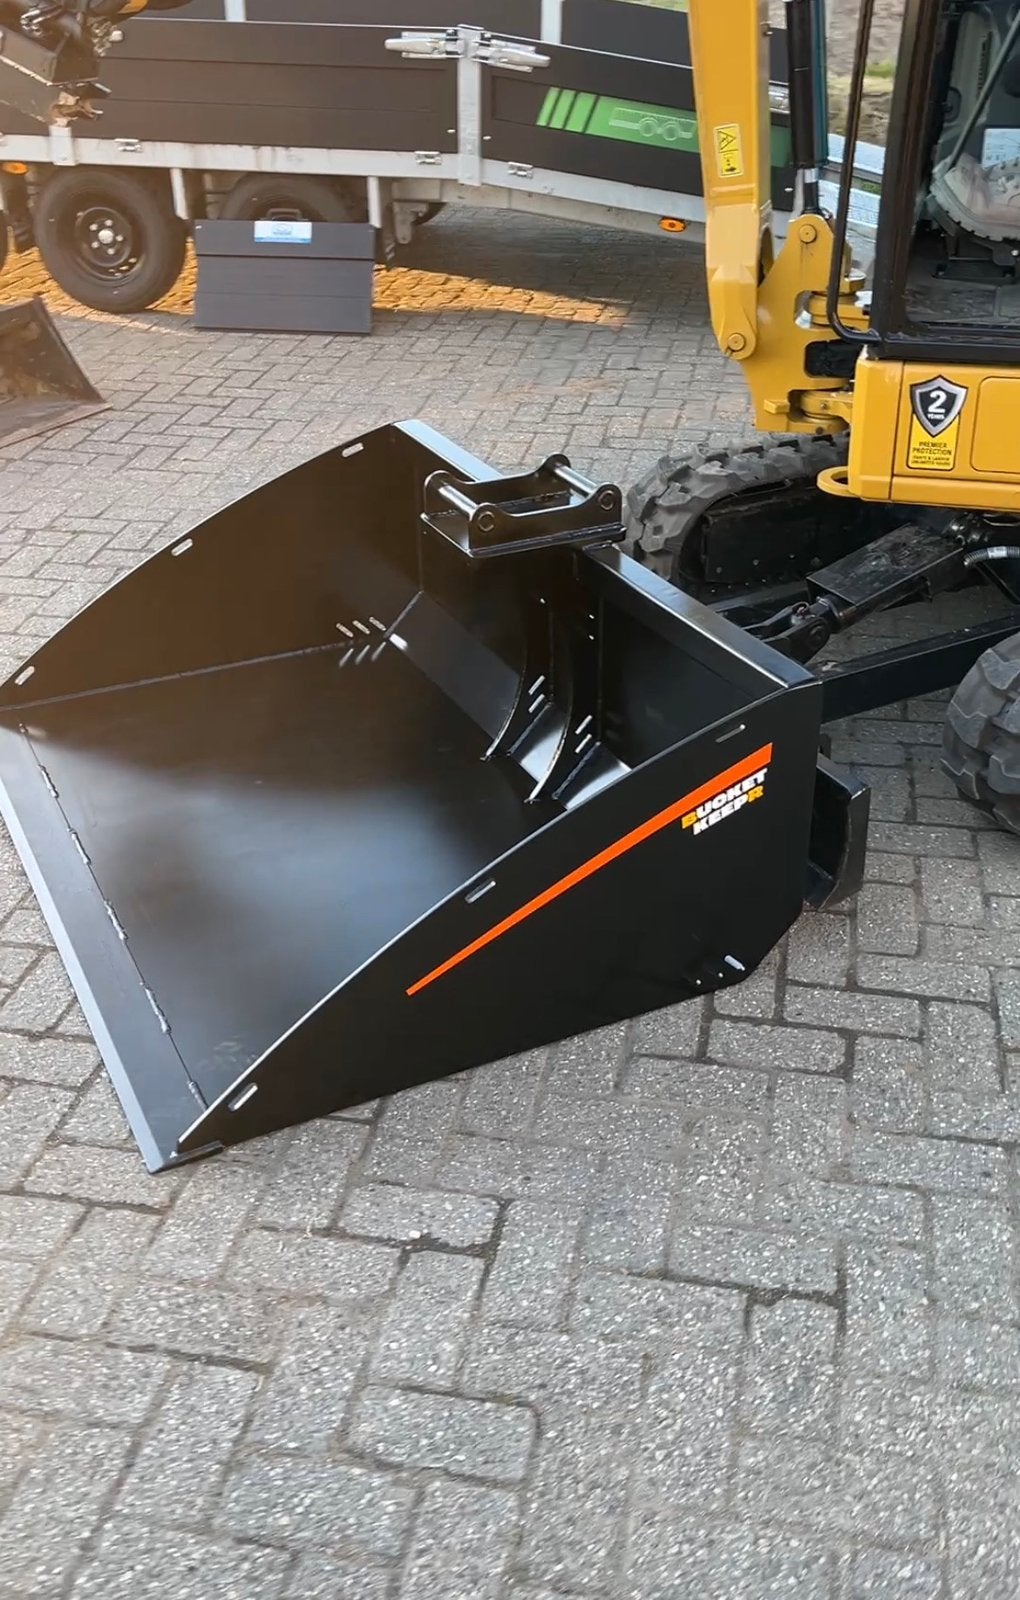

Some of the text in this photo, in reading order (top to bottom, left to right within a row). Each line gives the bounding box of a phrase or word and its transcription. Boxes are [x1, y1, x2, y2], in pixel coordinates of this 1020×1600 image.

[928, 390, 947, 413] 2
[912, 447, 952, 456] PROTECTION
[693, 785, 764, 835] KEEPR
